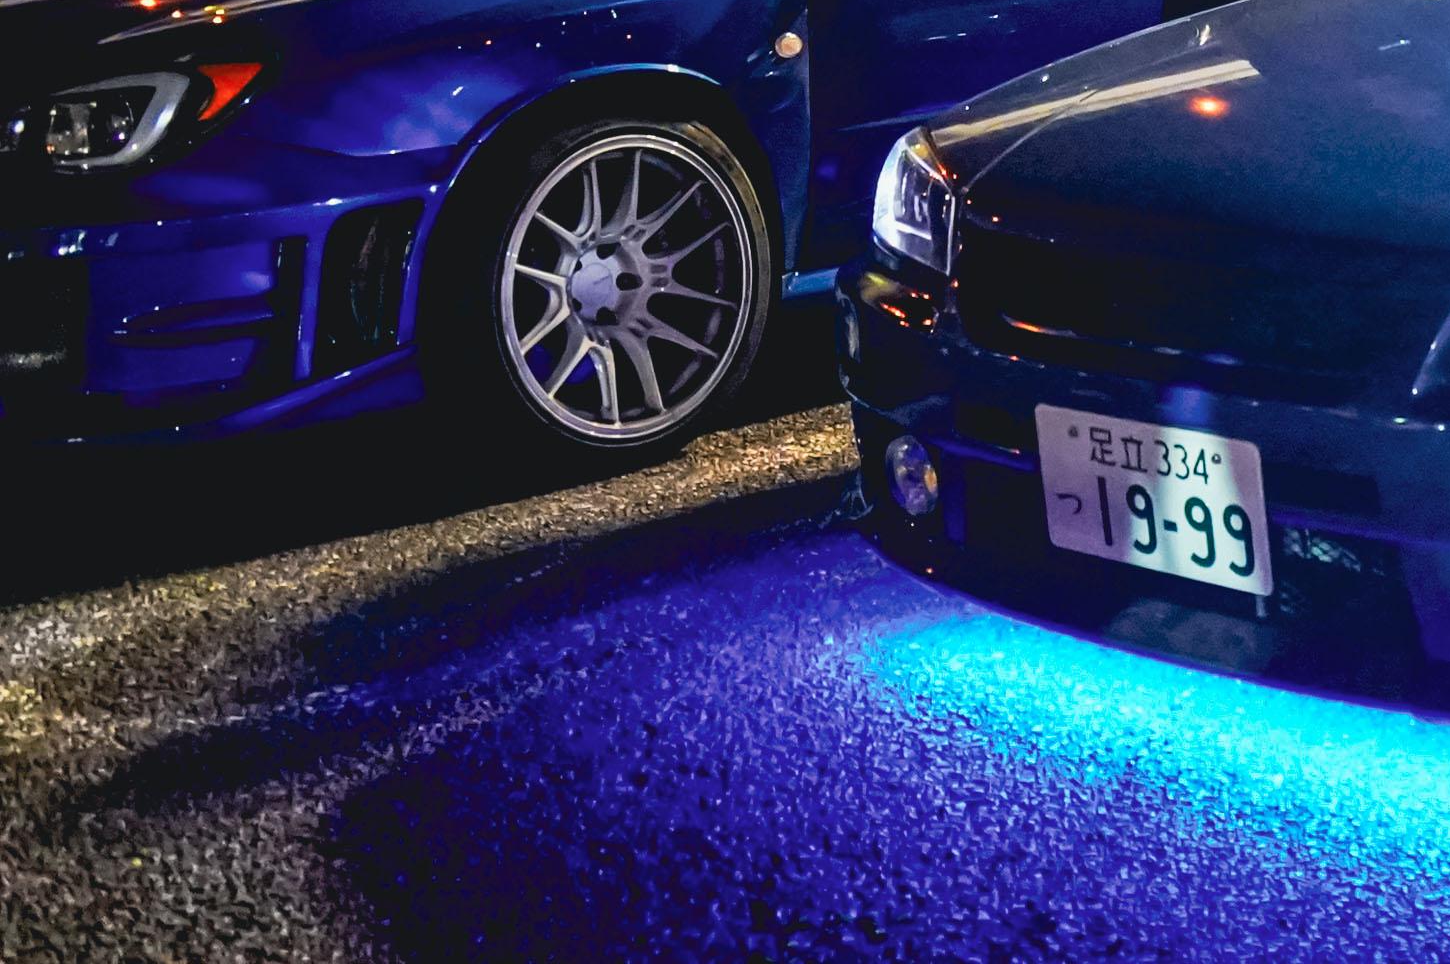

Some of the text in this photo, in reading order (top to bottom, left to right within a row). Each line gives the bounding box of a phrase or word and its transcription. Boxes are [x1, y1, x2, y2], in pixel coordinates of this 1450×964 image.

[1089, 427, 1209, 485] 足立 334
[1056, 476, 1256, 578] つ 19-99
